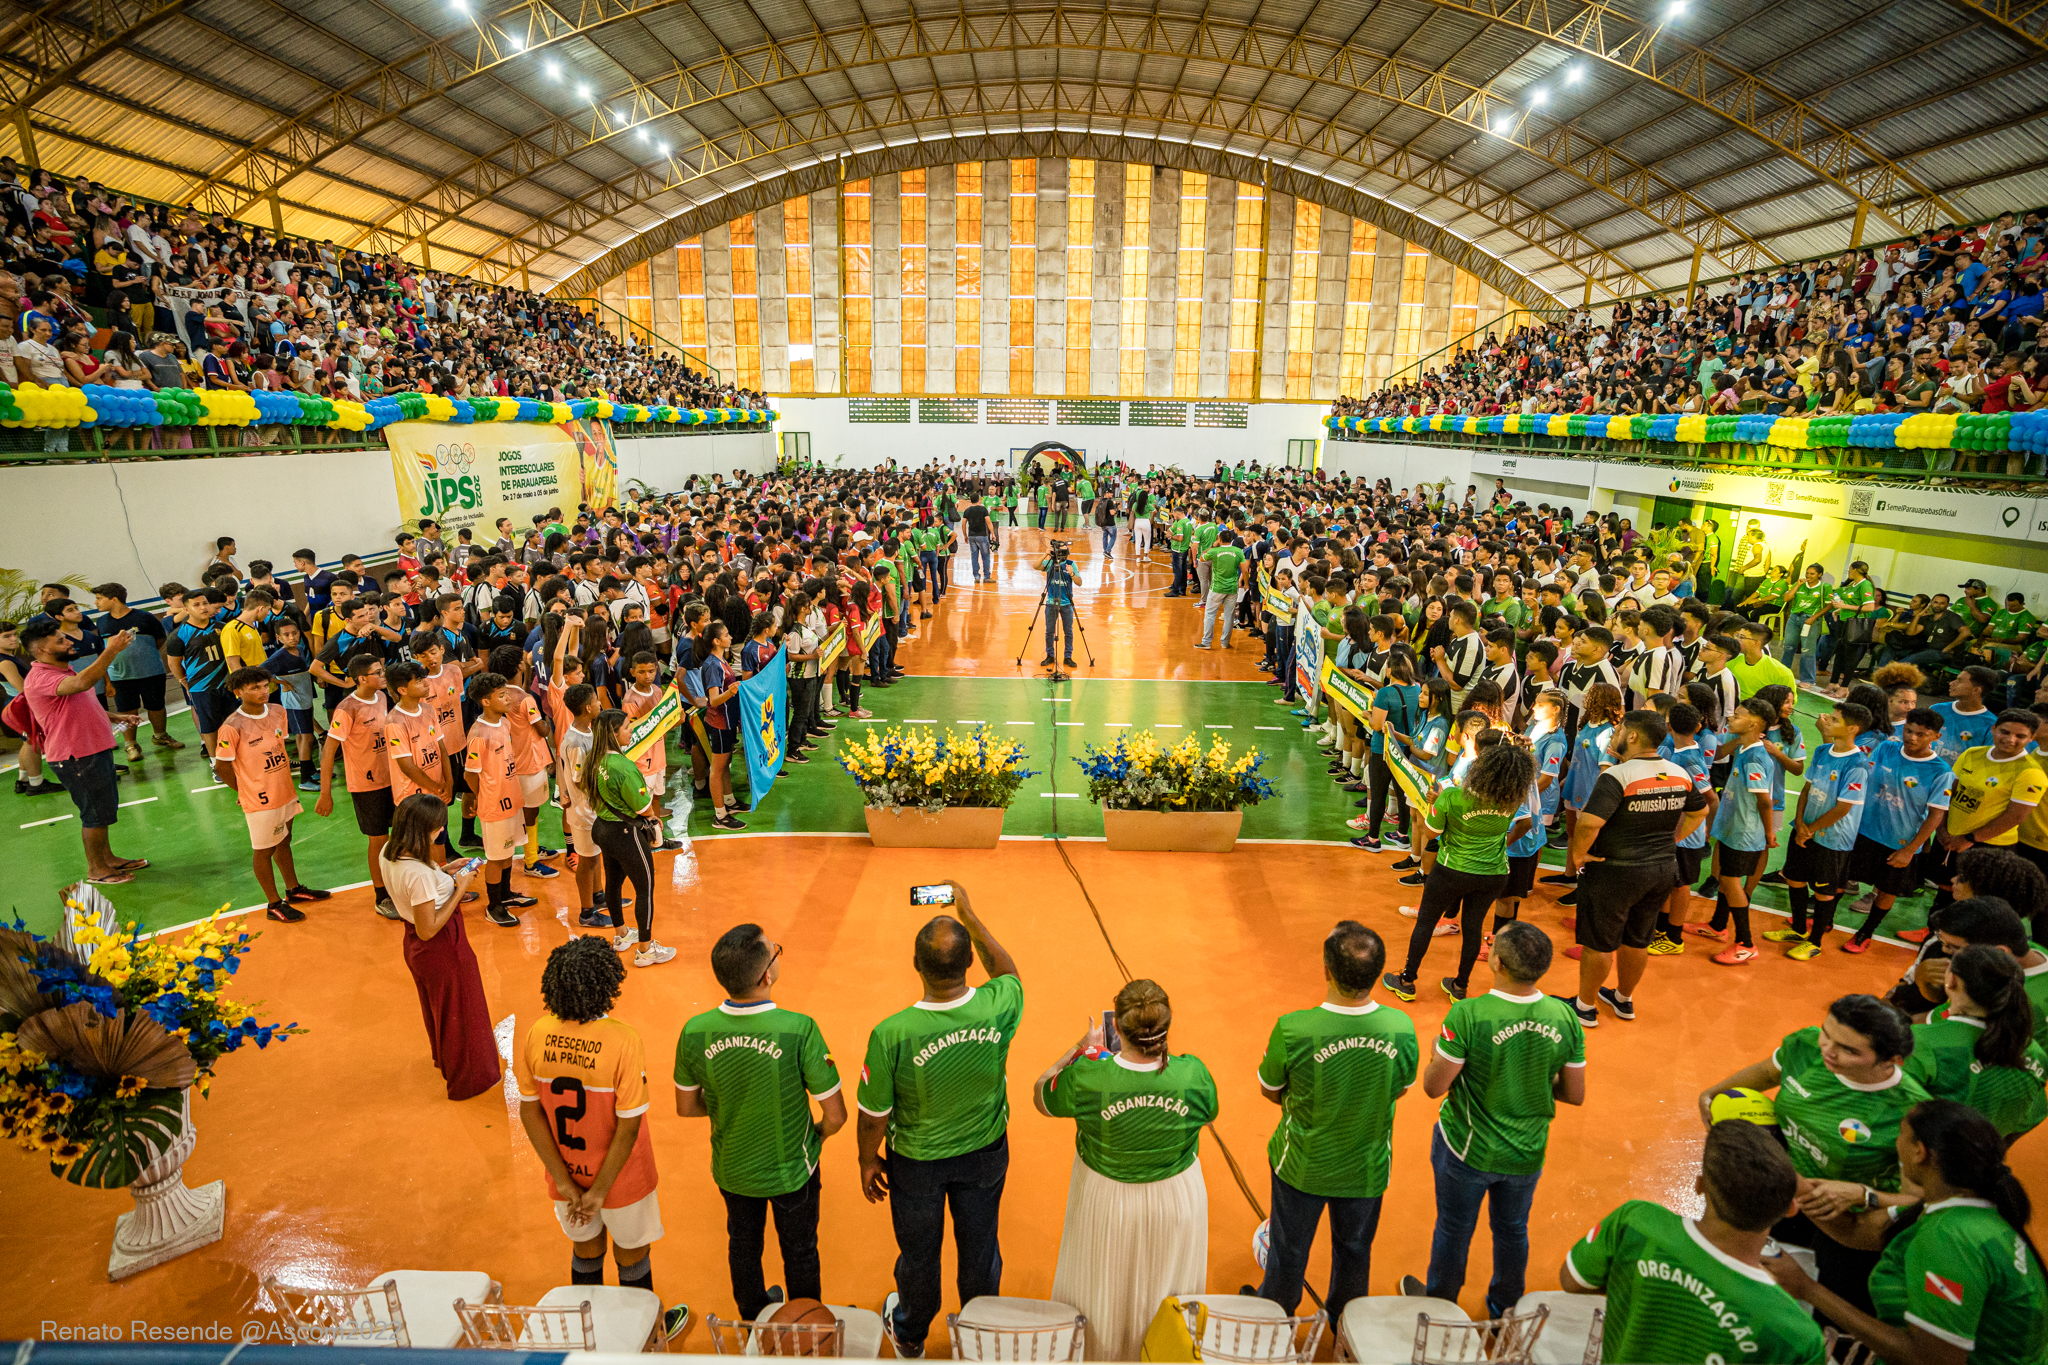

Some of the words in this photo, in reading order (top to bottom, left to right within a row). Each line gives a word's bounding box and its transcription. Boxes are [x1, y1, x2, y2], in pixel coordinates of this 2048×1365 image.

[498, 450, 522, 461] JOGOS
[499, 461, 555, 476] INTERESCOLARES
[501, 480, 512, 490] DE
[512, 475, 557, 489] PARAUAPEBAS
[1681, 480, 1714, 491] PARAUAPEBAS
[420, 472, 476, 516] JIPS
[473, 475, 483, 508] 2022
[1795, 494, 1840, 505] SemelParauapebas
[1886, 503, 1958, 518] SemelParauapebasOficial
[308, 587, 315, 599] 4
[205, 644, 220, 662] 11
[398, 645, 411, 662] 15
[535, 660, 547, 680] 14
[1331, 672, 1349, 694] Escola
[1348, 686, 1367, 710] Alicerce
[264, 752, 287, 770] JIPS
[421, 750, 439, 767] JIPS
[646, 758, 652, 769] 7
[258, 791, 269, 805] 5
[1637, 787, 1654, 796] ESCOLA
[499, 797, 513, 812] 10
[1628, 796, 1667, 812] COMISSÃO
[1492, 1020, 1562, 1046] ORGANIZAÇÃO
[545, 1034, 602, 1055] CRESCENDO
[704, 1036, 783, 1060] ORGANIZAÇÃO
[913, 1027, 1002, 1067] ORGANIZAÇÃO
[1313, 1036, 1398, 1063] ORGANIZAÇÃO
[543, 1049, 558, 1063] NA
[559, 1050, 596, 1070] PRÁTICA
[551, 1076, 586, 1151] 2
[1101, 1095, 1189, 1121] ORGANIZAÇÃO
[1637, 1259, 1758, 1353] ORGANIZAÇÃO
